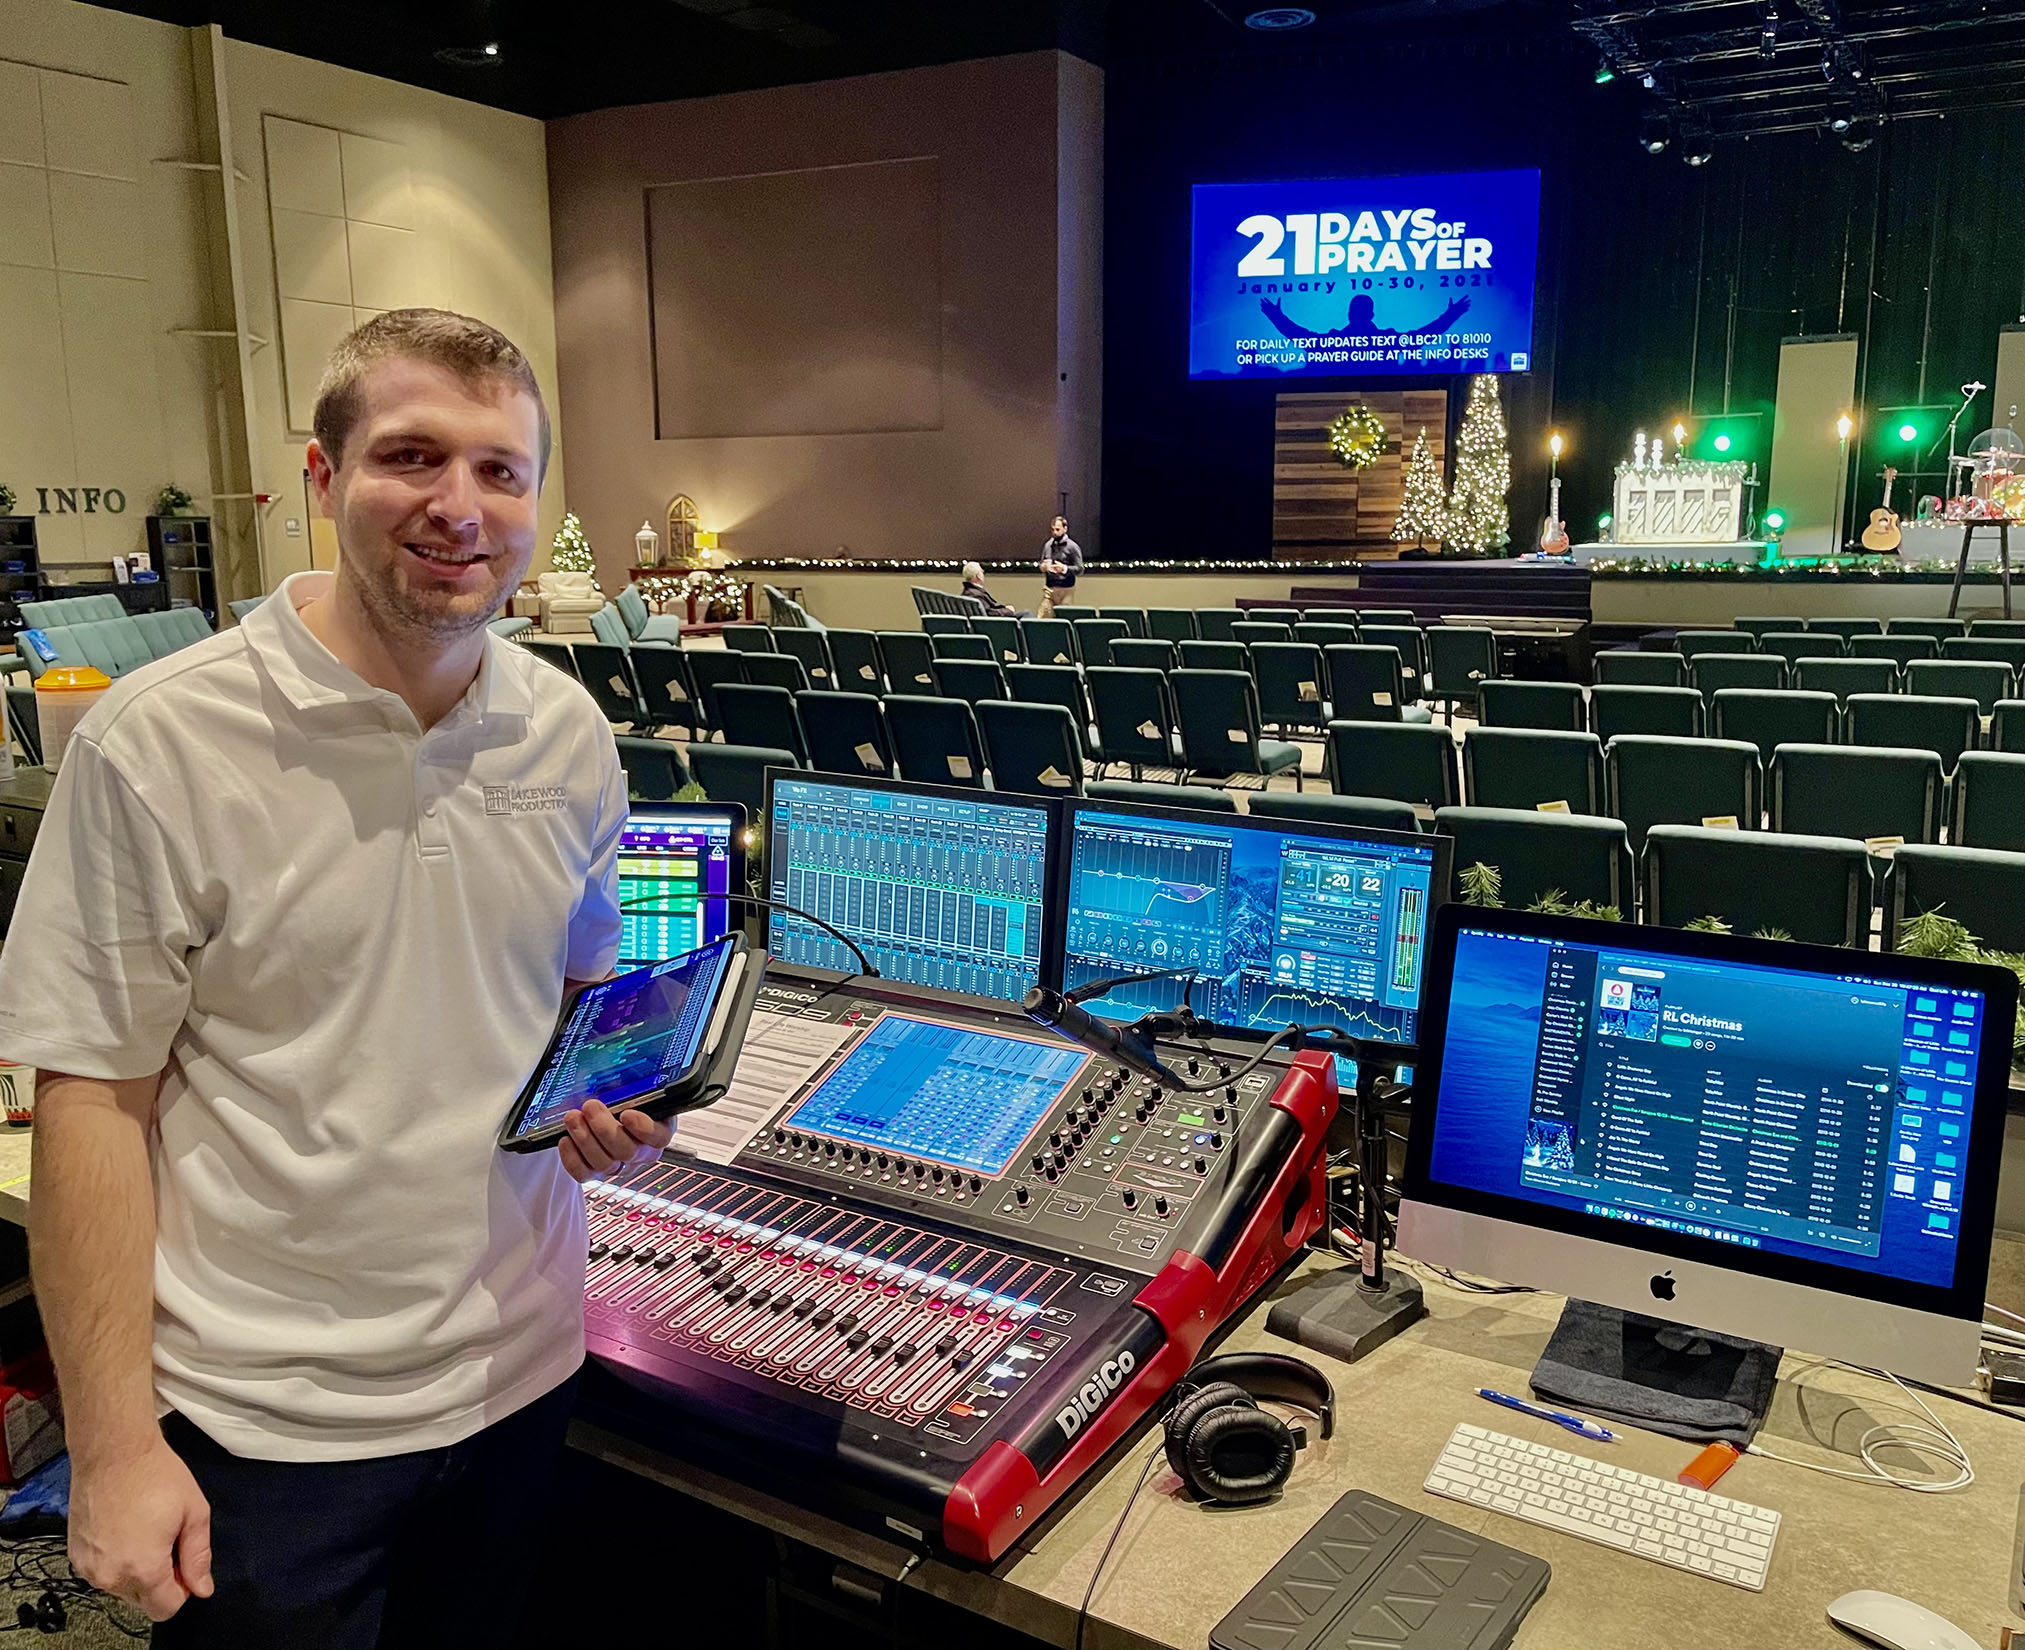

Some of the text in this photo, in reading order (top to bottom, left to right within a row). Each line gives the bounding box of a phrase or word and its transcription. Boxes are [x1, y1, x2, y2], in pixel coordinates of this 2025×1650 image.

[1236, 208, 1466, 277] 21 DAYS OF
[1318, 238, 1493, 274] PRAYER
[1237, 274, 1493, 294] January 10-30, 2021
[1236, 333, 1492, 350] FOR DAILY TEXT UPDATES TEXT @LBC21 TO 81010
[1237, 348, 1489, 365] OR PICK UP A PRAYER GUIDE AT THE INFO DESKS
[36, 488, 126, 514] INFO
[1290, 869, 1312, 882] -41
[1325, 873, 1350, 887] -20
[1361, 877, 1380, 891] 22
[1663, 1010, 1743, 1031] RL Christmas
[1055, 1350, 1135, 1440] DiGiCo
